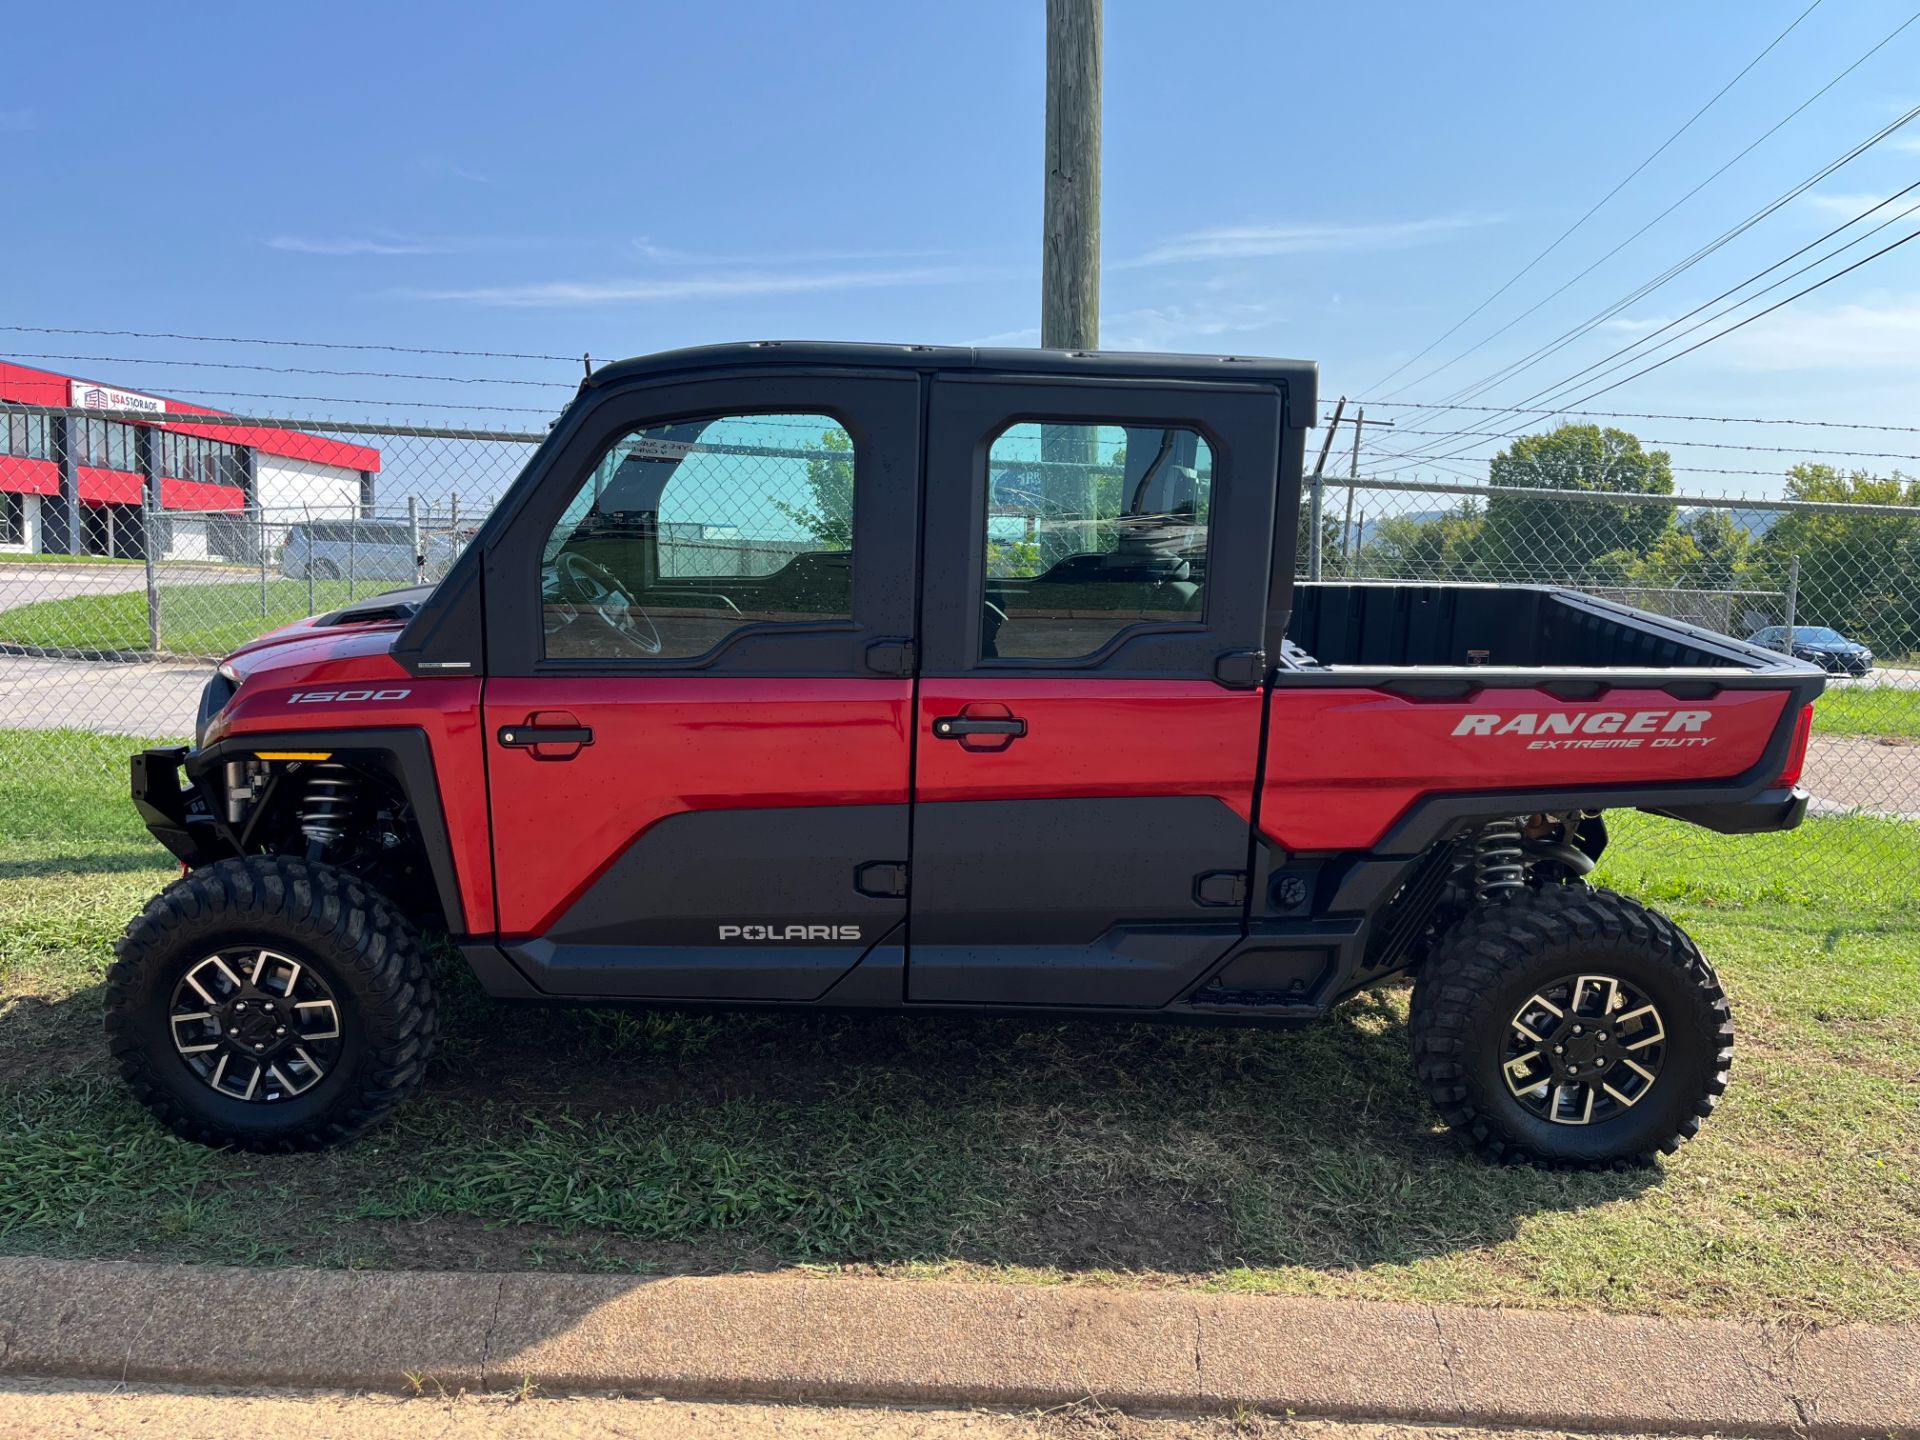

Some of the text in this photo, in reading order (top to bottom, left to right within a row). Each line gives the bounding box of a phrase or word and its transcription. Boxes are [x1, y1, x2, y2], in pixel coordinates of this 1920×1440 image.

[287, 689, 412, 704] 1500
[1450, 711, 1712, 736] RANGER
[1527, 737, 1717, 750] EXTREME DUTY
[719, 925, 861, 940] POLARIS
